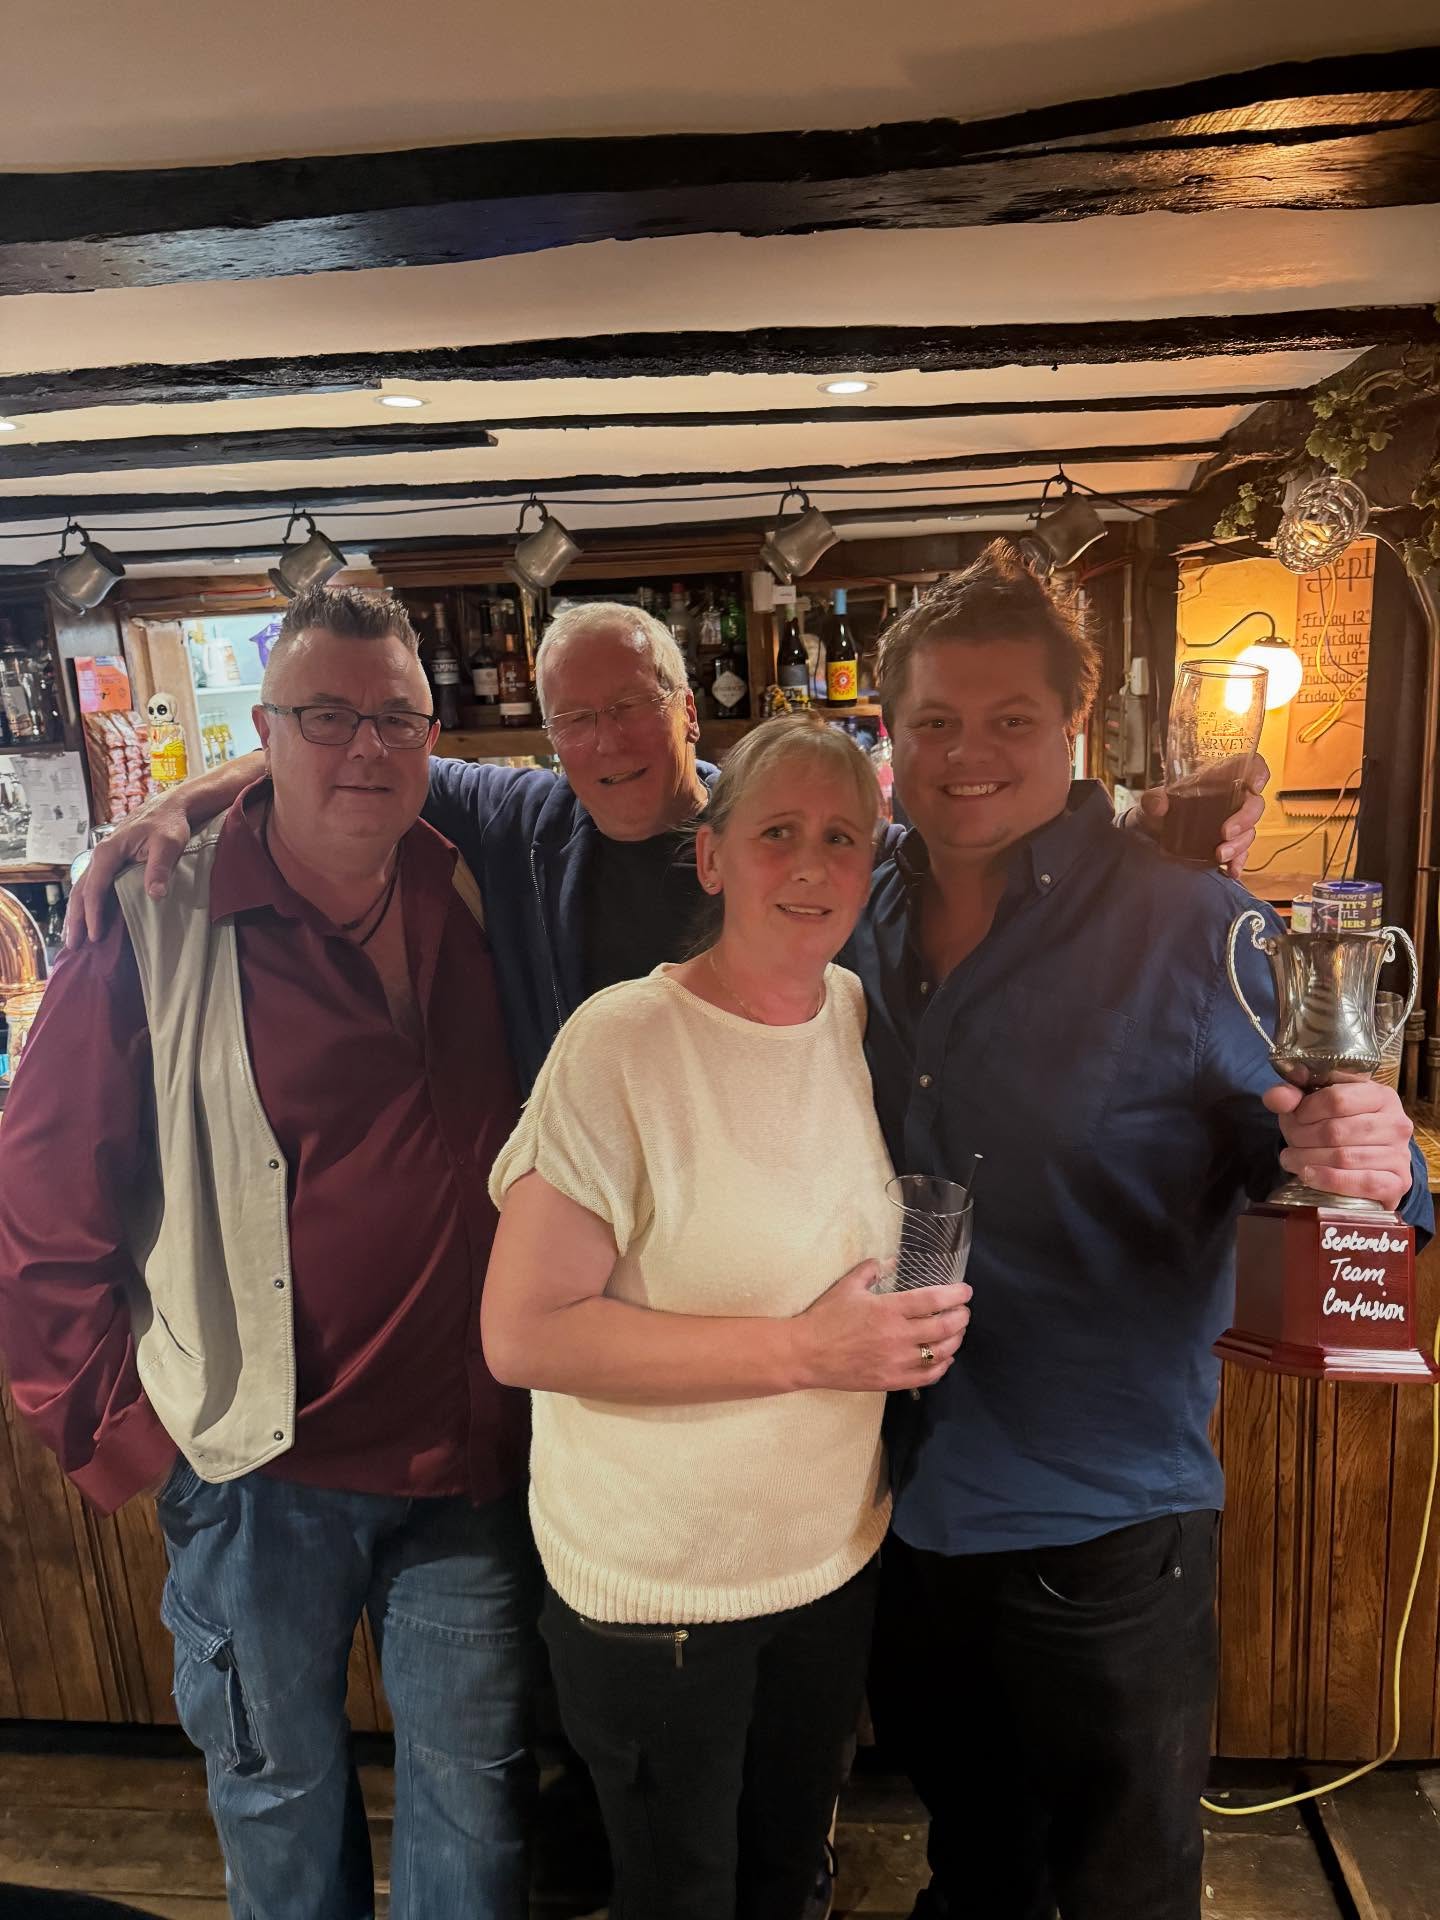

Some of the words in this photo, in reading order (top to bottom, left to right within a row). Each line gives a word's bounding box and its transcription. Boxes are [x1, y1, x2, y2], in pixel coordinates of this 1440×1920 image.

[1322, 1227, 1408, 1252] September
[1330, 1257, 1385, 1286] Team
[1323, 1287, 1404, 1321] Confusion
